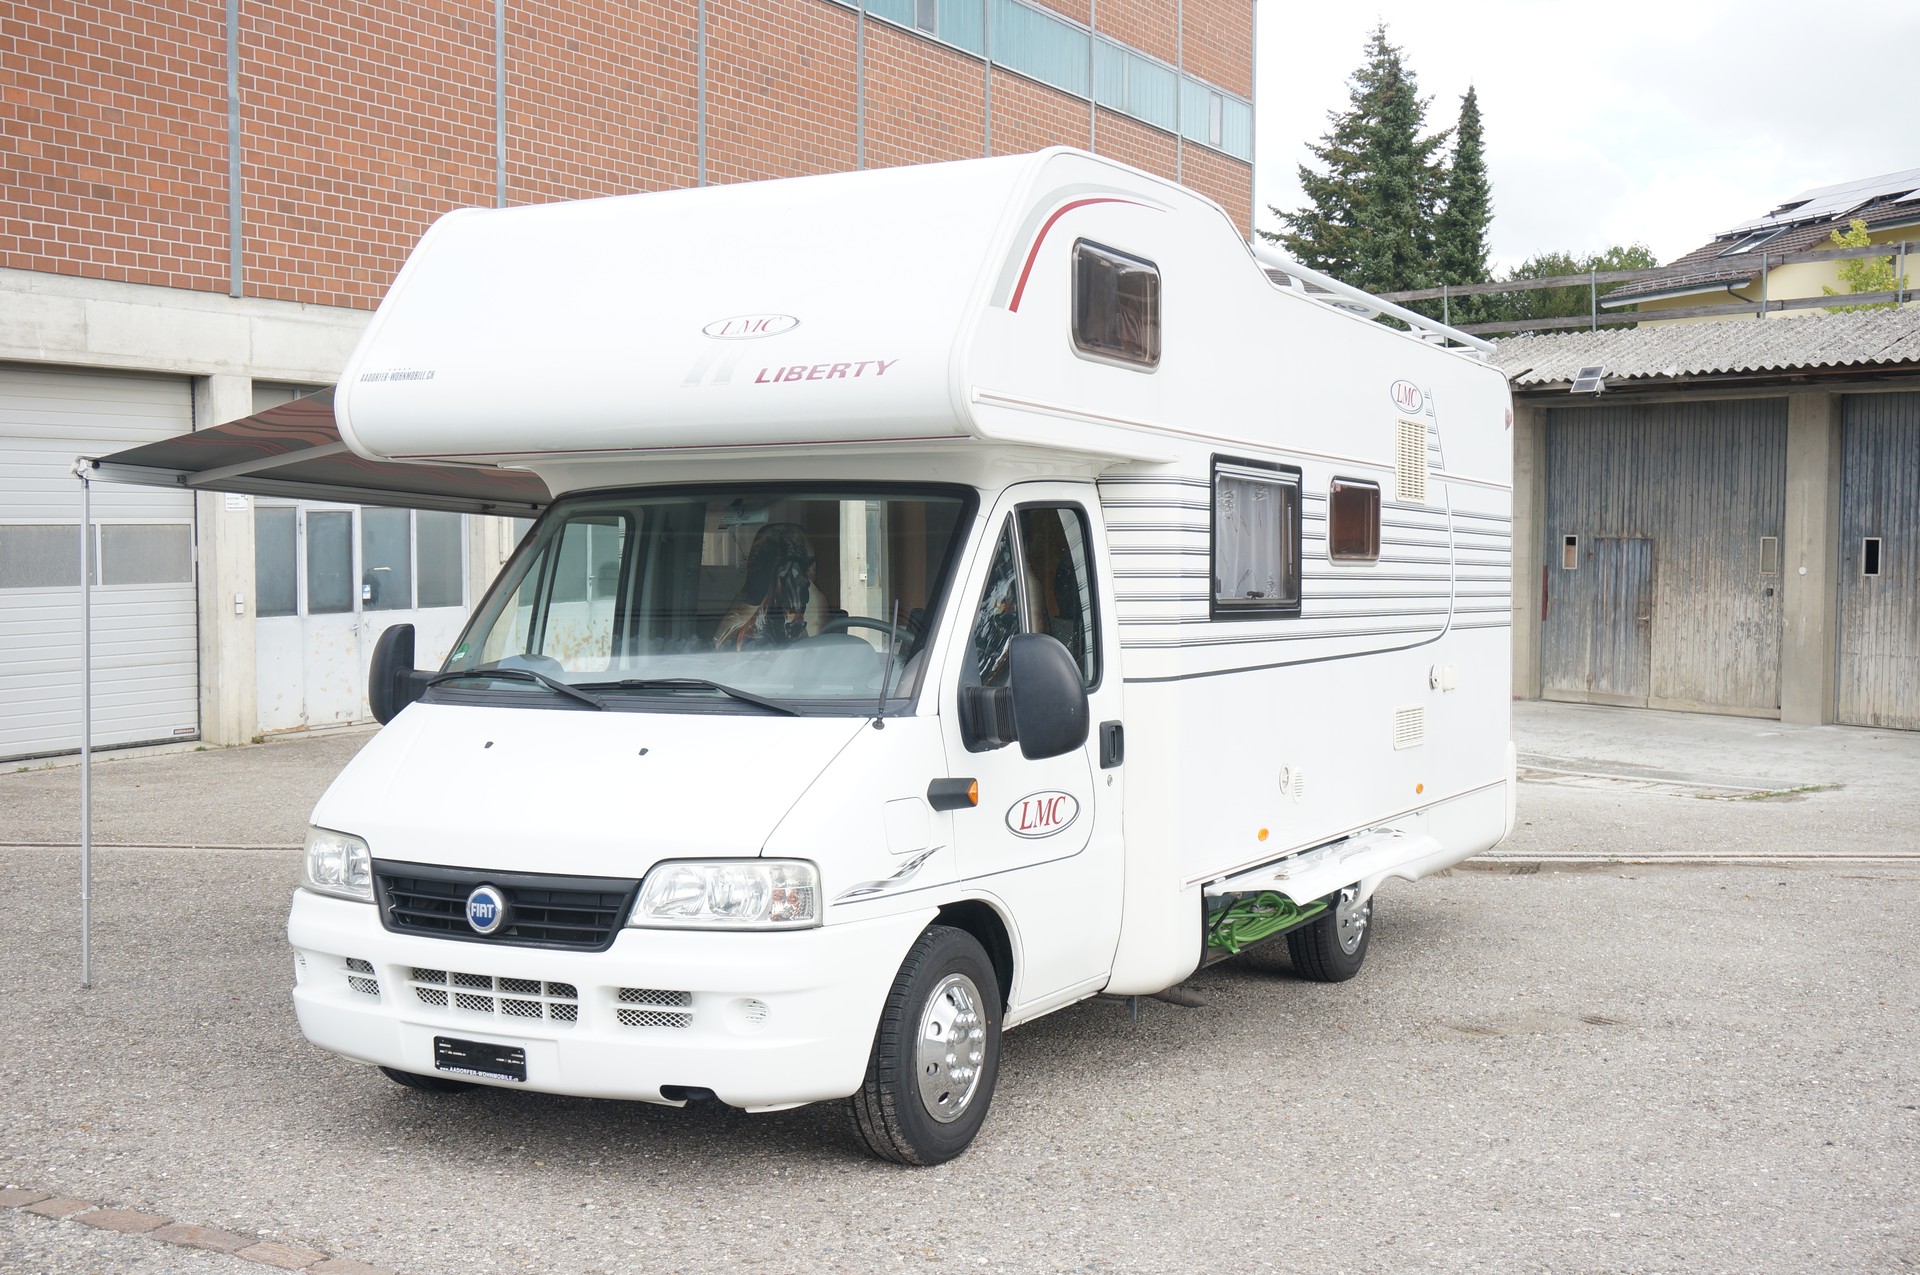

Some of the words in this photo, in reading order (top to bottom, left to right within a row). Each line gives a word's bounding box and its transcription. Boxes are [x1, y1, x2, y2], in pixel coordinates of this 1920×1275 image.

[720, 317, 783, 335] LMC
[754, 358, 900, 384] LIBERTY
[1396, 383, 1417, 408] LMC
[1019, 795, 1067, 831] LMC
[471, 902, 495, 919] FIAT
